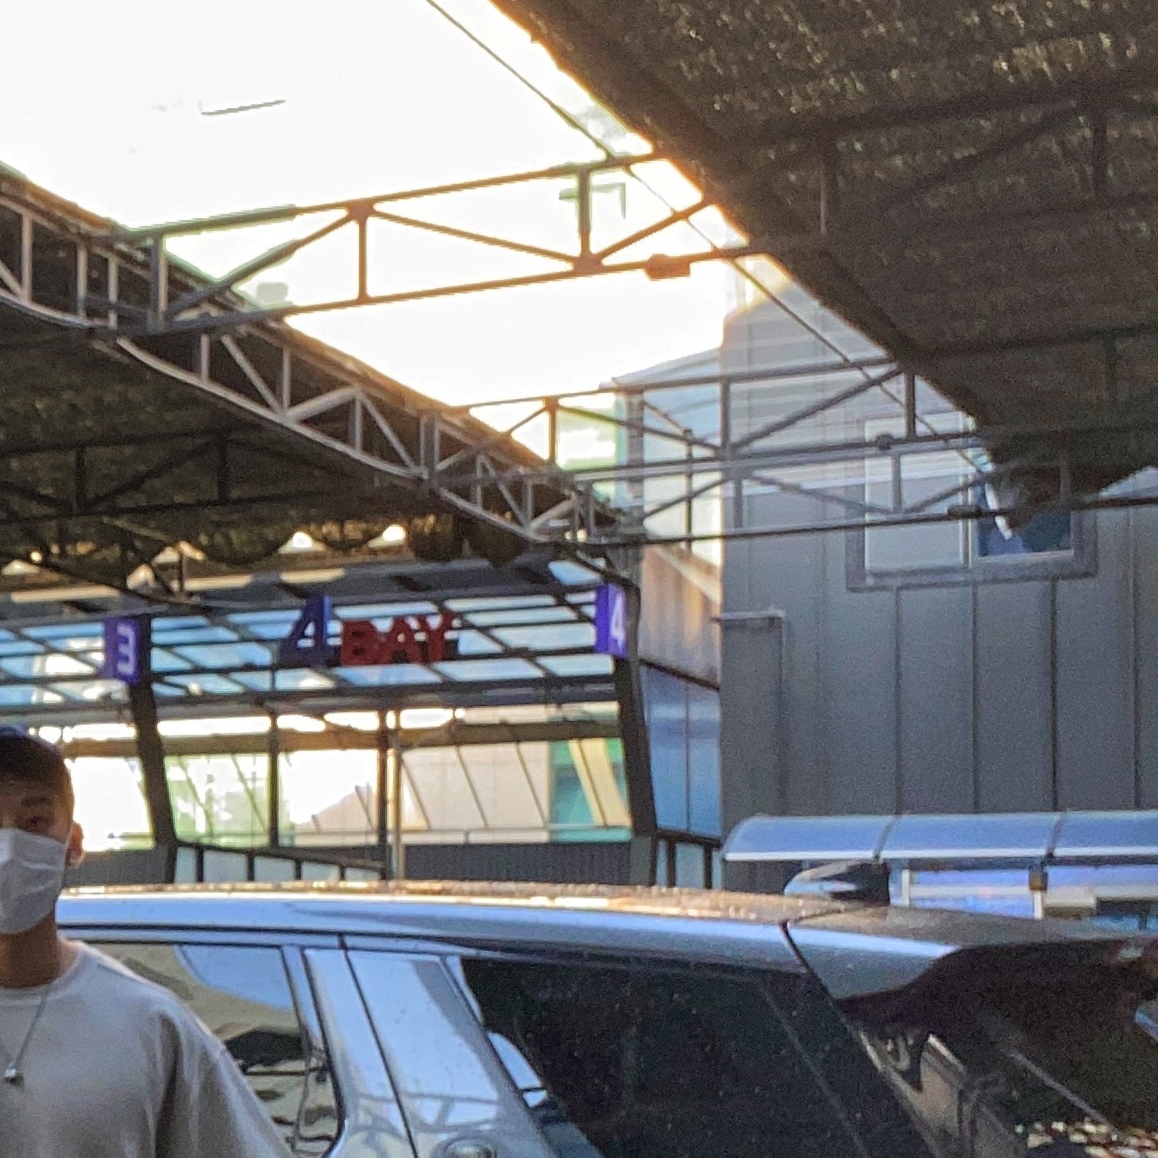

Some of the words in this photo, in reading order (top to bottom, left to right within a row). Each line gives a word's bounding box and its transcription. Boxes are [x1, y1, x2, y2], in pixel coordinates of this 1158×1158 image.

[116, 622, 135, 676] 3
[280, 592, 333, 668] 4
[341, 612, 461, 665] BAY
[610, 592, 624, 650] 4
